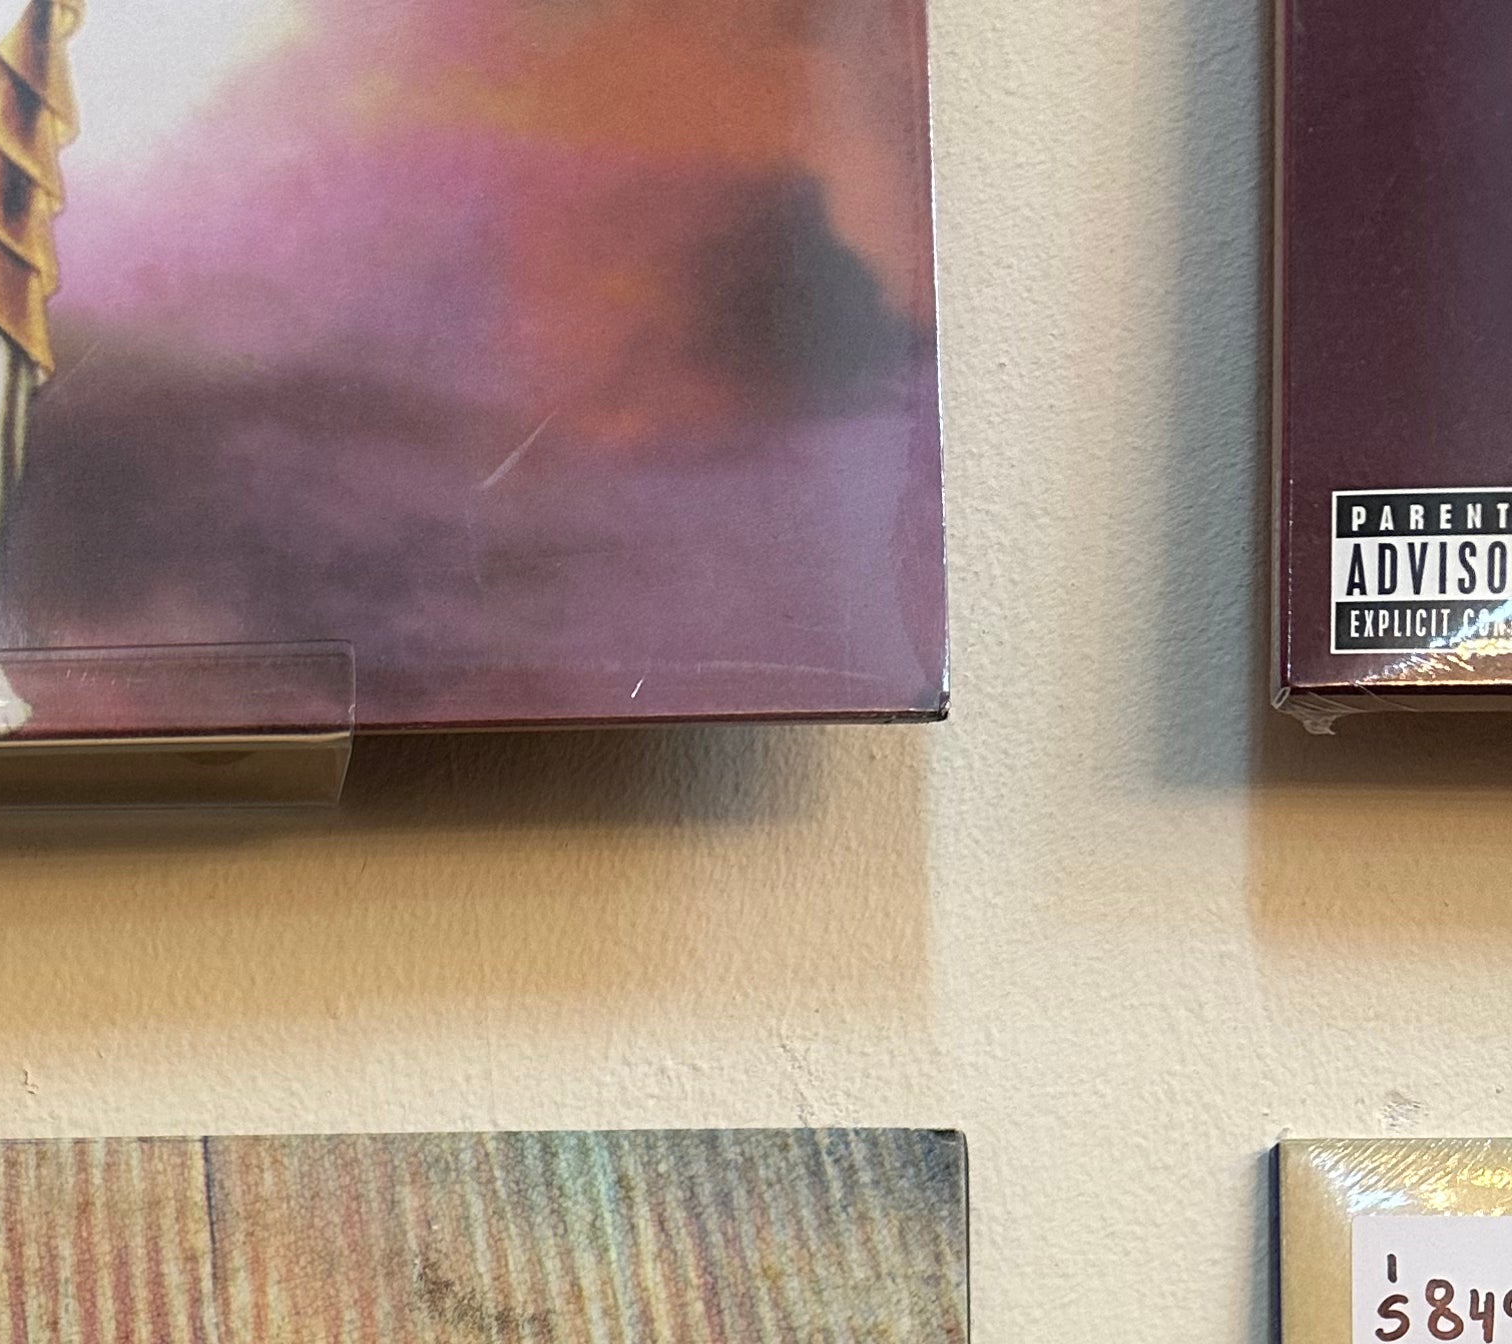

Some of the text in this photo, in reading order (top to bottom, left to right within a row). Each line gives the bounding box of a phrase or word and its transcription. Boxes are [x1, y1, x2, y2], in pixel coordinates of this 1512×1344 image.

[1351, 503, 1509, 531] PARENT
[1346, 541, 1507, 595] ADVISO
[1350, 609, 1450, 637] EXPLICIT
